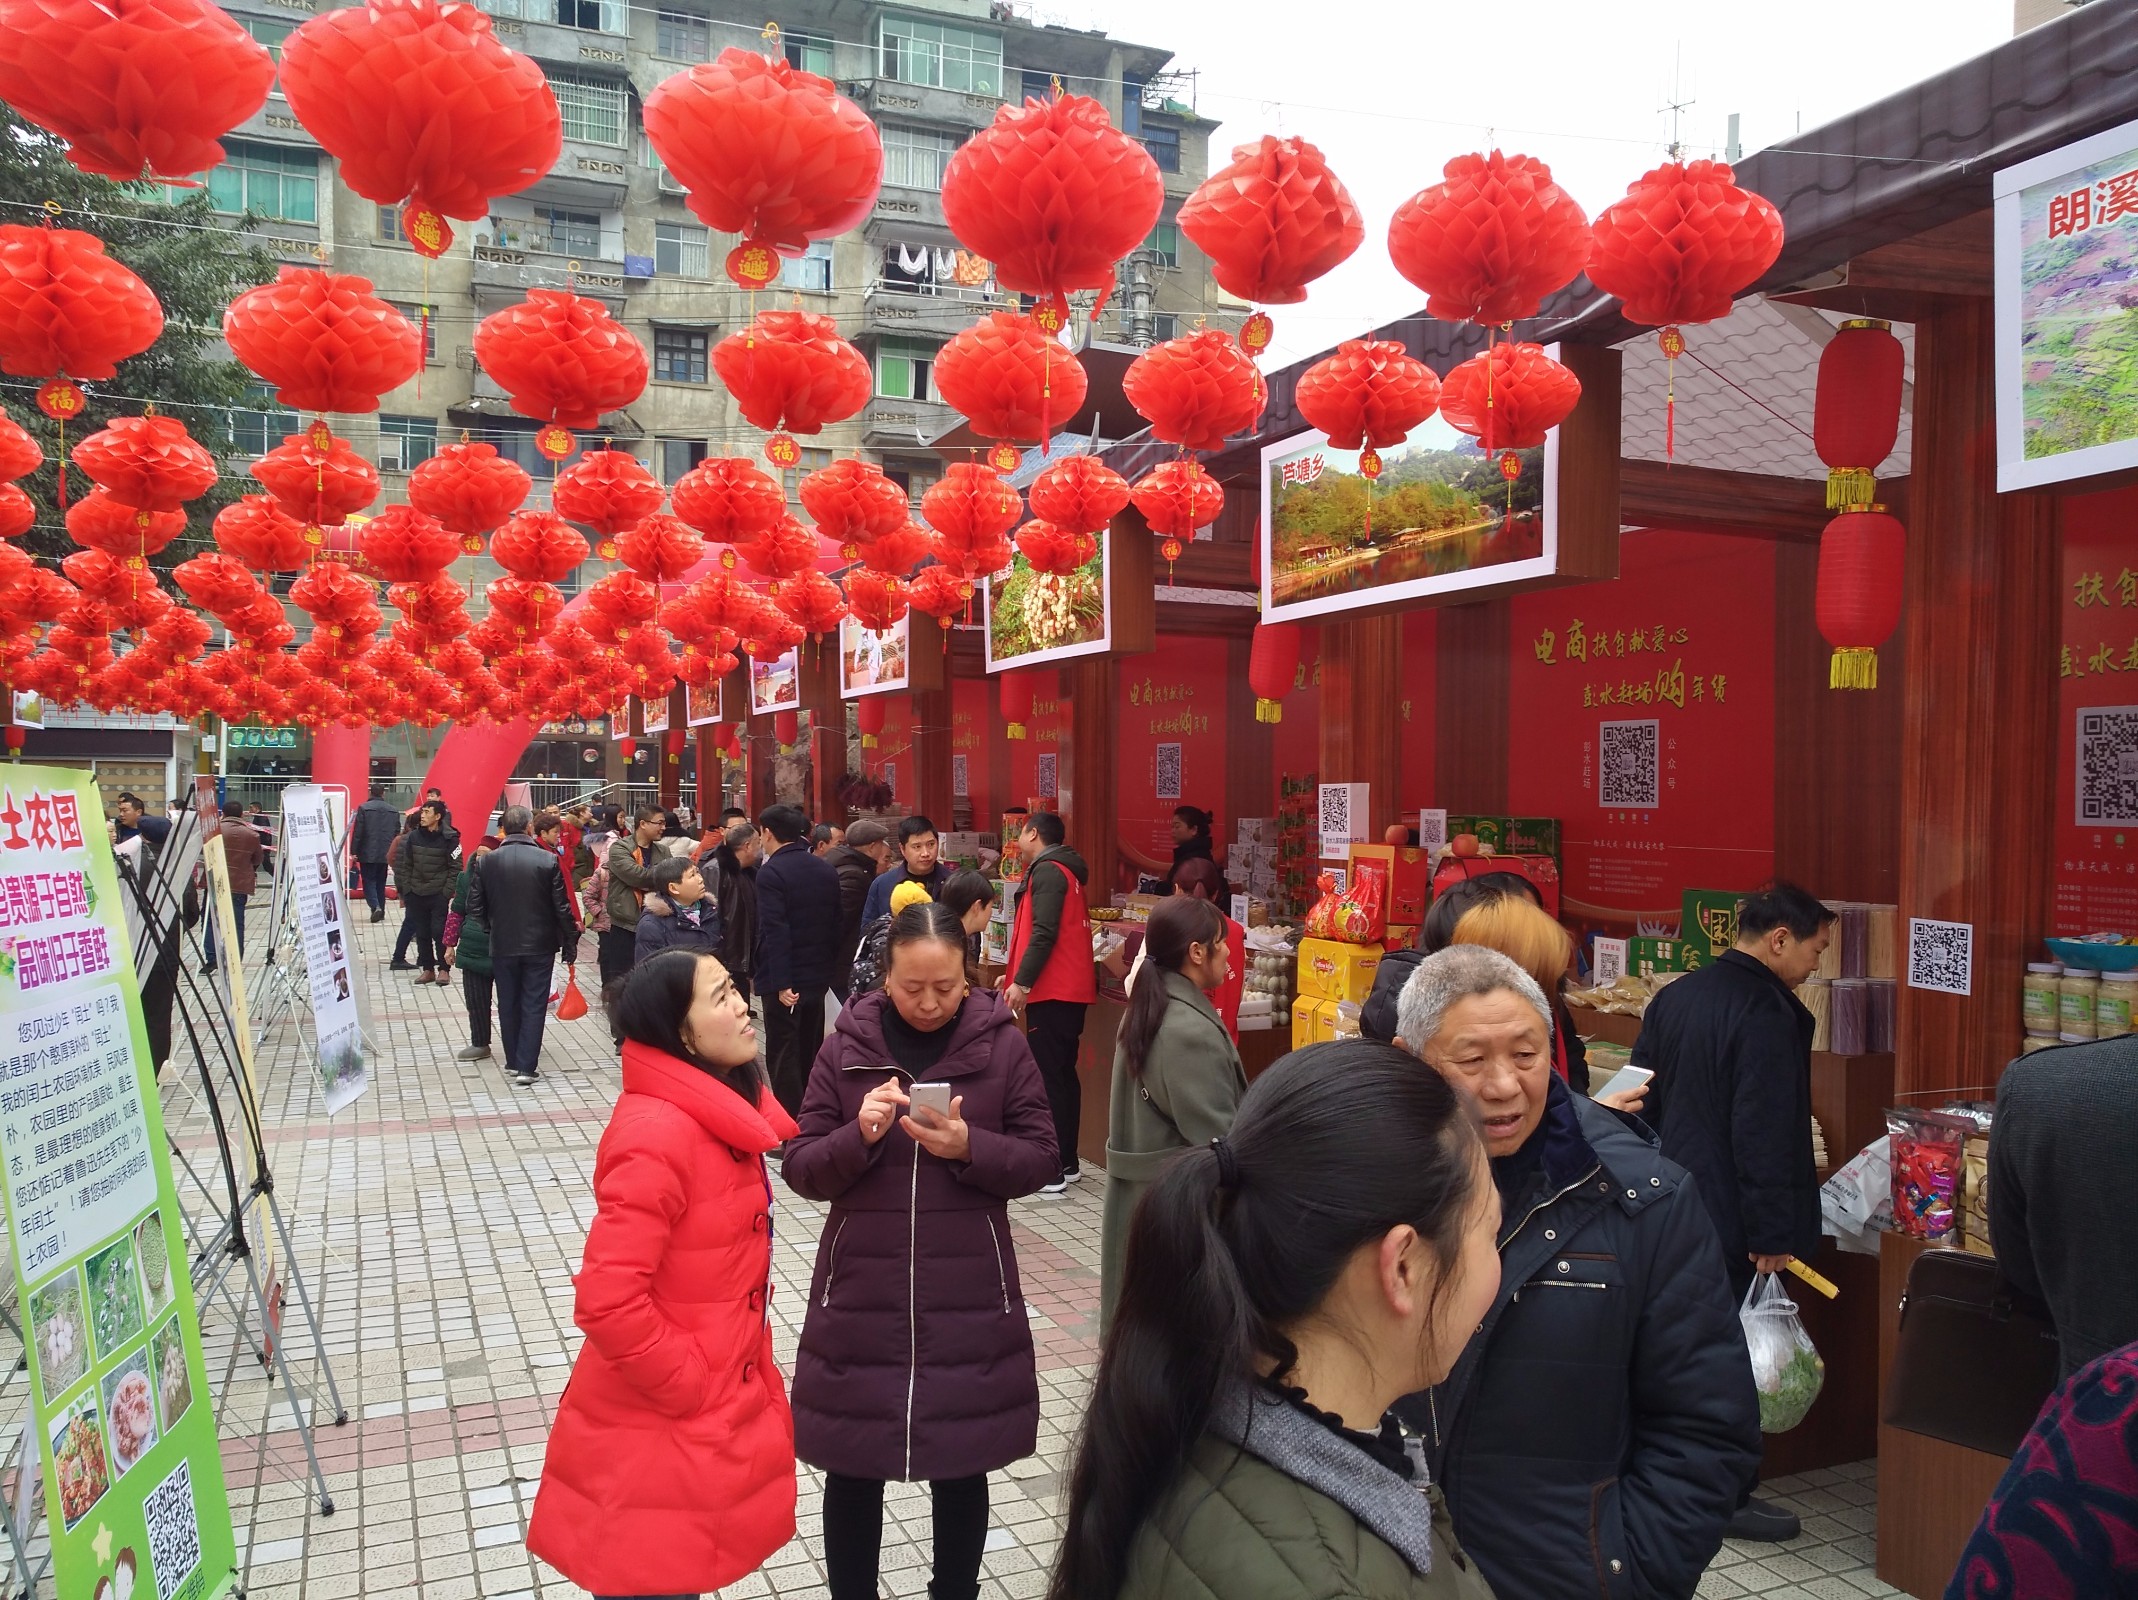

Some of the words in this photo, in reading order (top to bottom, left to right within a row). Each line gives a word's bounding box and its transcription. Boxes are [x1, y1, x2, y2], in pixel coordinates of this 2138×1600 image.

[1040, 309, 1060, 331] 福
[1664, 334, 1680, 353] 福
[47, 386, 75, 411] 福
[313, 427, 329, 451] 福
[772, 439, 795, 461] 福
[1282, 452, 1325, 488] 芦塘乡
[1364, 455, 1378, 472] 福
[1504, 457, 1517, 474] 福
[464, 538, 481, 551] 福
[843, 545, 858, 559] 福
[1166, 544, 1178, 556] 福
[127, 558, 144, 571] 福
[2074, 567, 2138, 608] 扶贫
[1534, 618, 1689, 665] 电商扶贫献爱心
[1583, 658, 1728, 708] 彭水赶场购年货
[1583, 741, 1591, 789] 彭水赶场
[1667, 738, 1676, 789] 公众号
